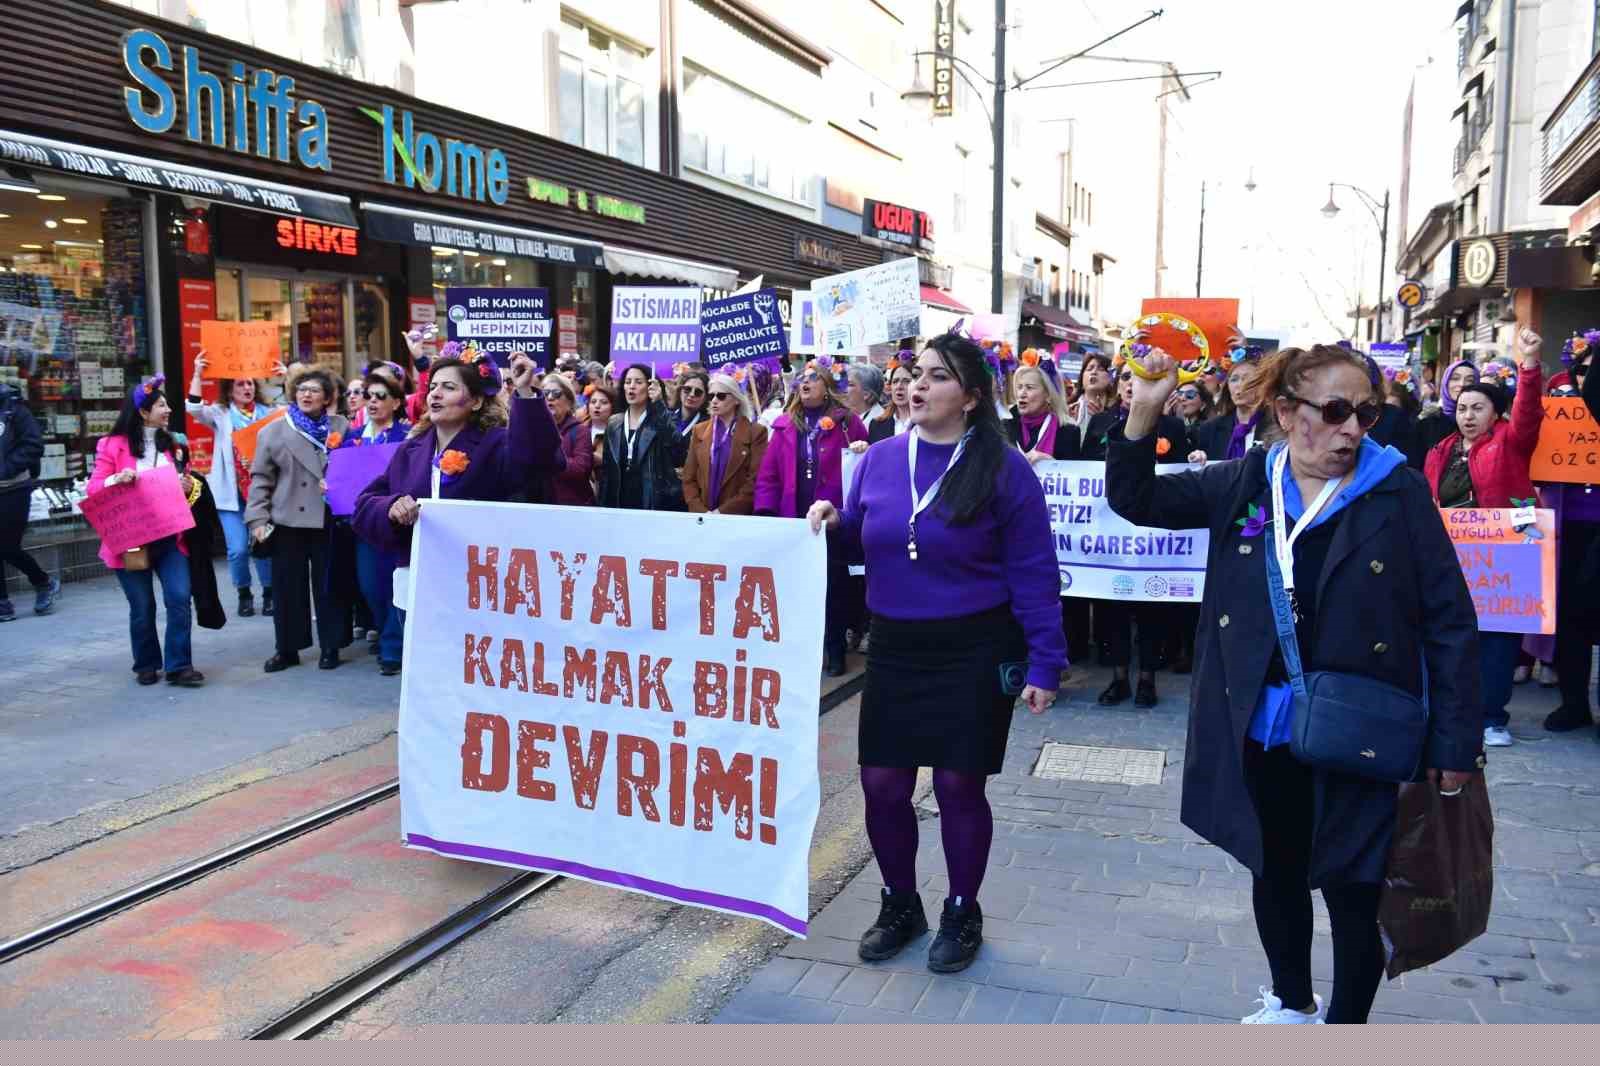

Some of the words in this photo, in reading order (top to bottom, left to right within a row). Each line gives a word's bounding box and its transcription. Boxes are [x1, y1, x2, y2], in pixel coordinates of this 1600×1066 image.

[936, 58, 950, 107] MODA
[122, 28, 332, 172] Shiffa
[382, 104, 509, 205] Home
[276, 215, 358, 255] SİRKE
[468, 296, 489, 308] BİR
[492, 298, 544, 308] KADININ
[615, 293, 697, 319] İSTİSMARI
[469, 311, 505, 319] NEFESİNİ
[701, 315, 753, 334] KARARLI
[470, 322, 544, 335] HEPİMİZİN
[705, 325, 778, 349] ÖZGÜRLÜKTE
[614, 331, 696, 352] AKLAMA!
[1040, 473, 1073, 497] ĞİL
[1080, 531, 1194, 556] ÇARESİYİZ!
[1450, 527, 1505, 540] UYGULA
[466, 544, 781, 643] HAYATTA
[463, 633, 674, 712] KALMAK
[693, 649, 782, 729] BİR
[461, 710, 778, 846] DEVRİM!
